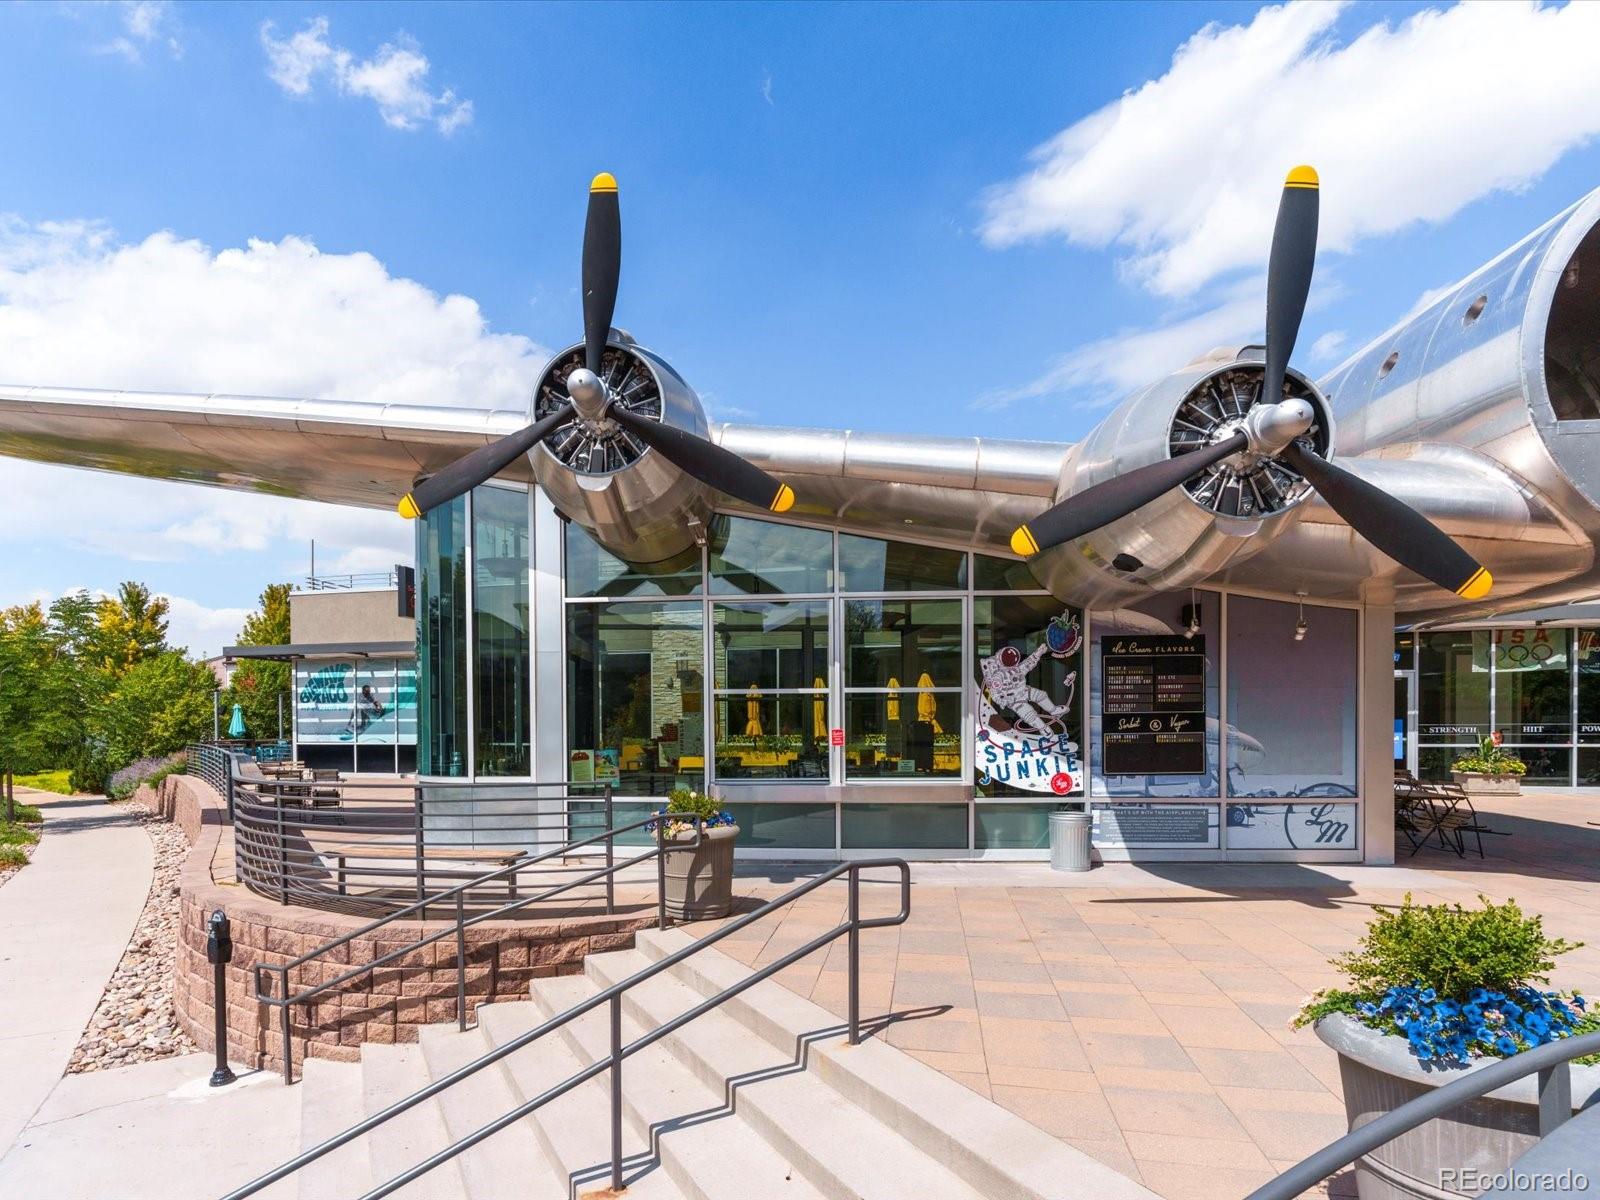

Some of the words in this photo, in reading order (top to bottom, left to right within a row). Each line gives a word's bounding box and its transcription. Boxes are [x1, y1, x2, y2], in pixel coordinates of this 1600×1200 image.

[1128, 642, 1153, 653] Cream
[1118, 717, 1141, 730] Sorbet
[1170, 714, 1190, 733] Vegan
[1429, 726, 1478, 734] STRENGTH
[1522, 725, 1545, 734] HIIT
[984, 733, 1070, 763] SPACE
[980, 753, 1078, 784] JUNKIE
